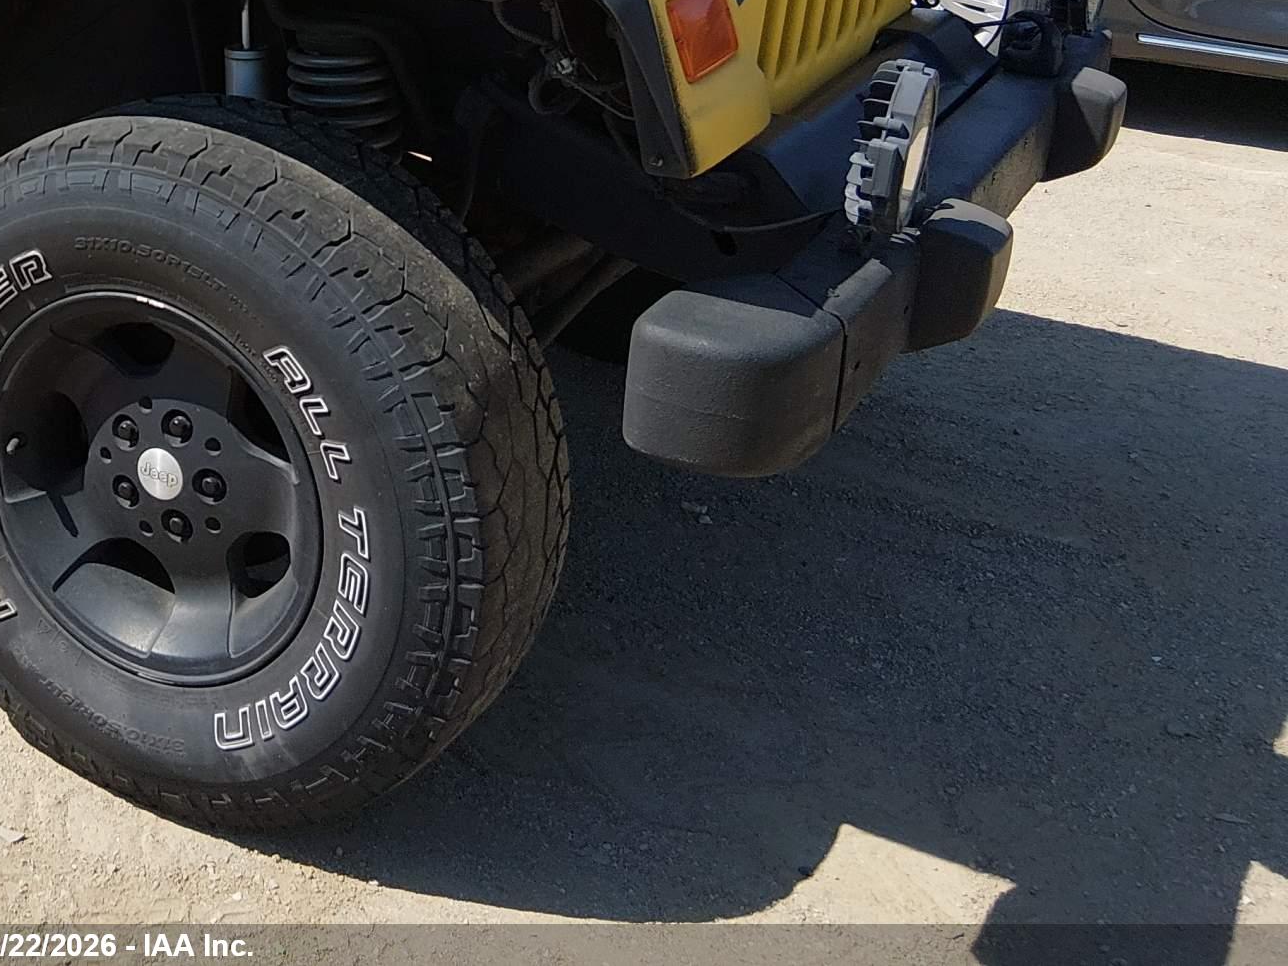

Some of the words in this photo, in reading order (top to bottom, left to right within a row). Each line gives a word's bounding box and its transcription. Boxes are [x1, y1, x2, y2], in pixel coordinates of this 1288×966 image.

[140, 462, 178, 489] Jeep
[260, 344, 353, 484] ALL
[213, 503, 371, 753] TERRAIN
